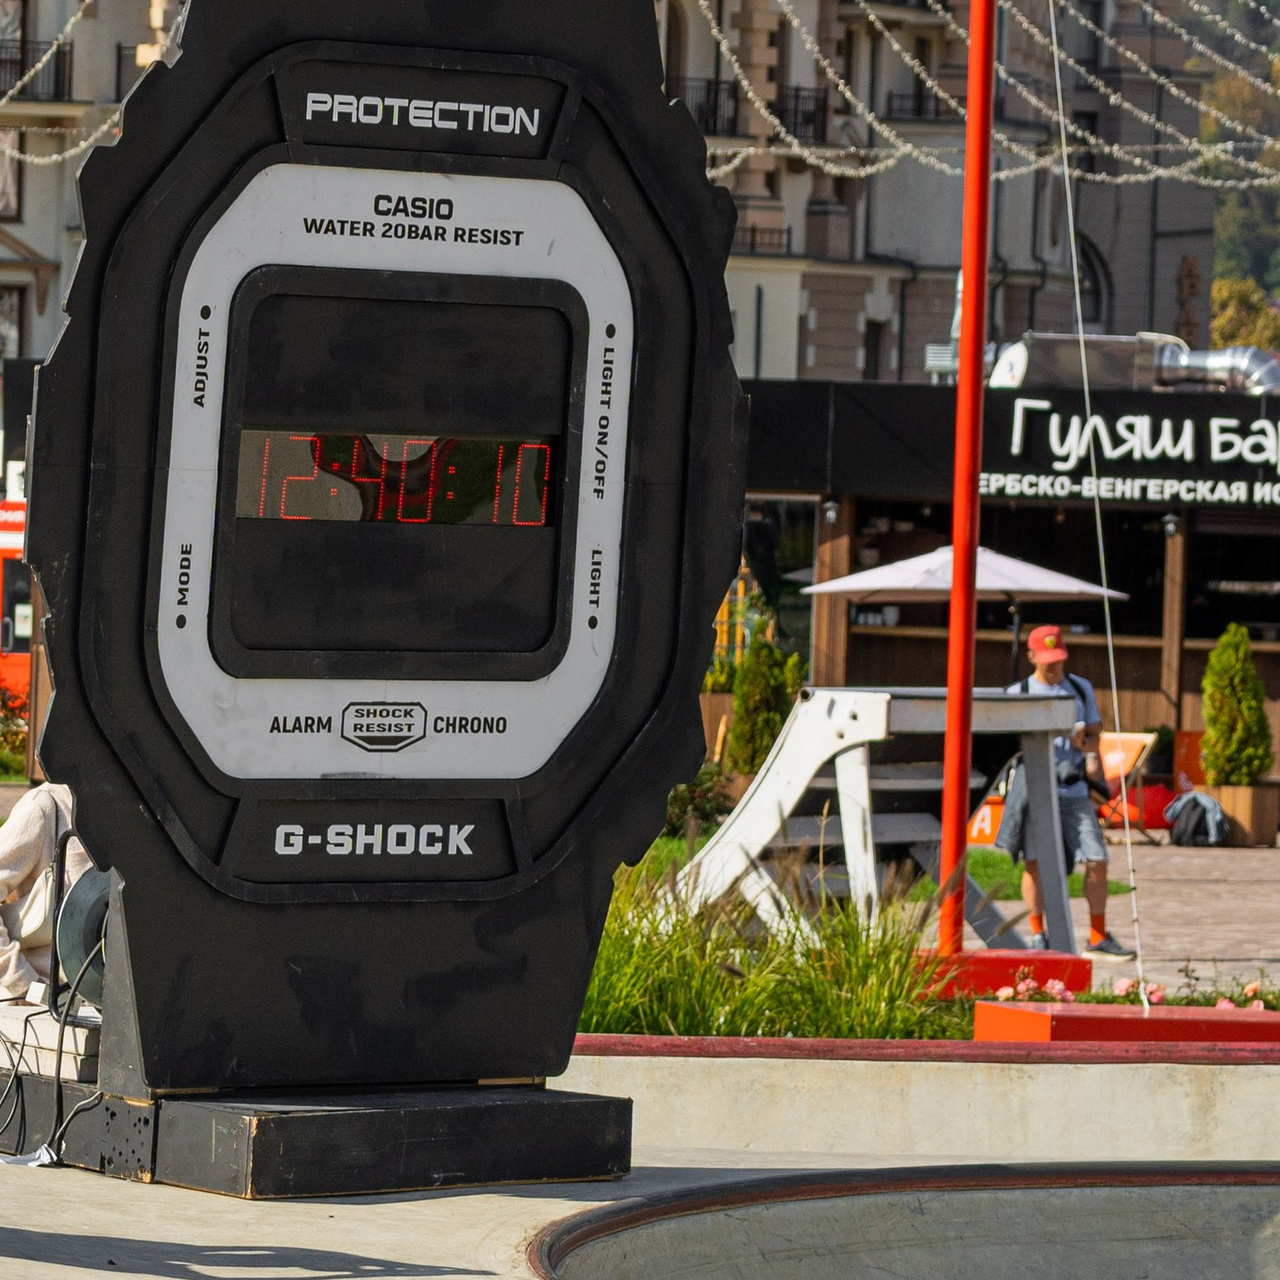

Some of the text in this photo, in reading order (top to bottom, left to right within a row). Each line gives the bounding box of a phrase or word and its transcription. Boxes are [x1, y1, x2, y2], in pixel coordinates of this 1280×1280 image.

[305, 91, 540, 136] PROTECTION
[373, 194, 454, 220] CASIO
[303, 217, 525, 247] WATER 20BAR RESIST
[192, 326, 211, 409] ADJUST
[592, 346, 616, 500] LIGHT ON/OFF
[1010, 397, 1280, 477] Гуляш Ба
[978, 472, 1248, 504] ЕРБСКО-ВЕНГЕРСКАЯ
[177, 542, 193, 607] MODE
[588, 549, 604, 609] LIGHT
[269, 716, 333, 734] ALARM
[353, 723, 416, 733] RESIST
[354, 708, 416, 719] SHOCK
[433, 716, 508, 734] CHRONO
[274, 823, 476, 856] G-SHOCK
